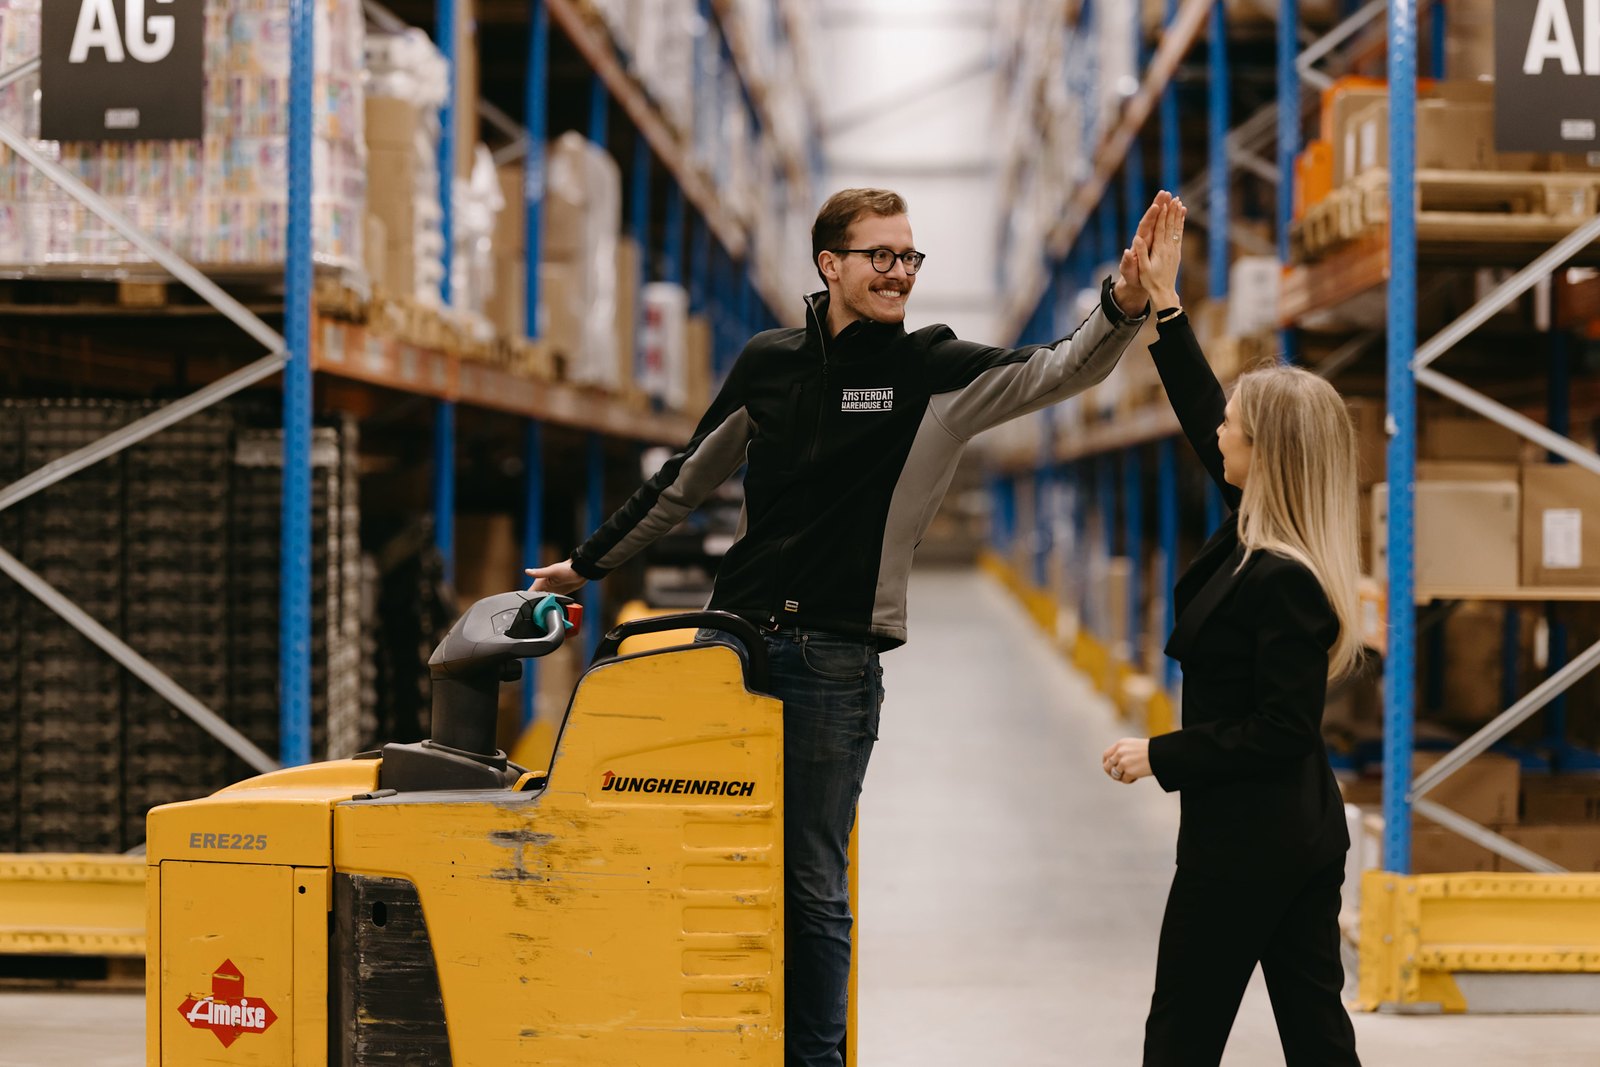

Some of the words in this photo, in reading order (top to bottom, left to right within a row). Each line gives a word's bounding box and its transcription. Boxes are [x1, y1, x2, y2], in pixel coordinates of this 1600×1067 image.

[69, 0, 175, 63] AG
[841, 401, 882, 409] WAREHOUSE
[842, 391, 893, 401] AMSTERDAM
[601, 776, 755, 796] JUNGHEINRICH
[189, 832, 267, 850] ERE225
[187, 997, 265, 1028] Ameise
